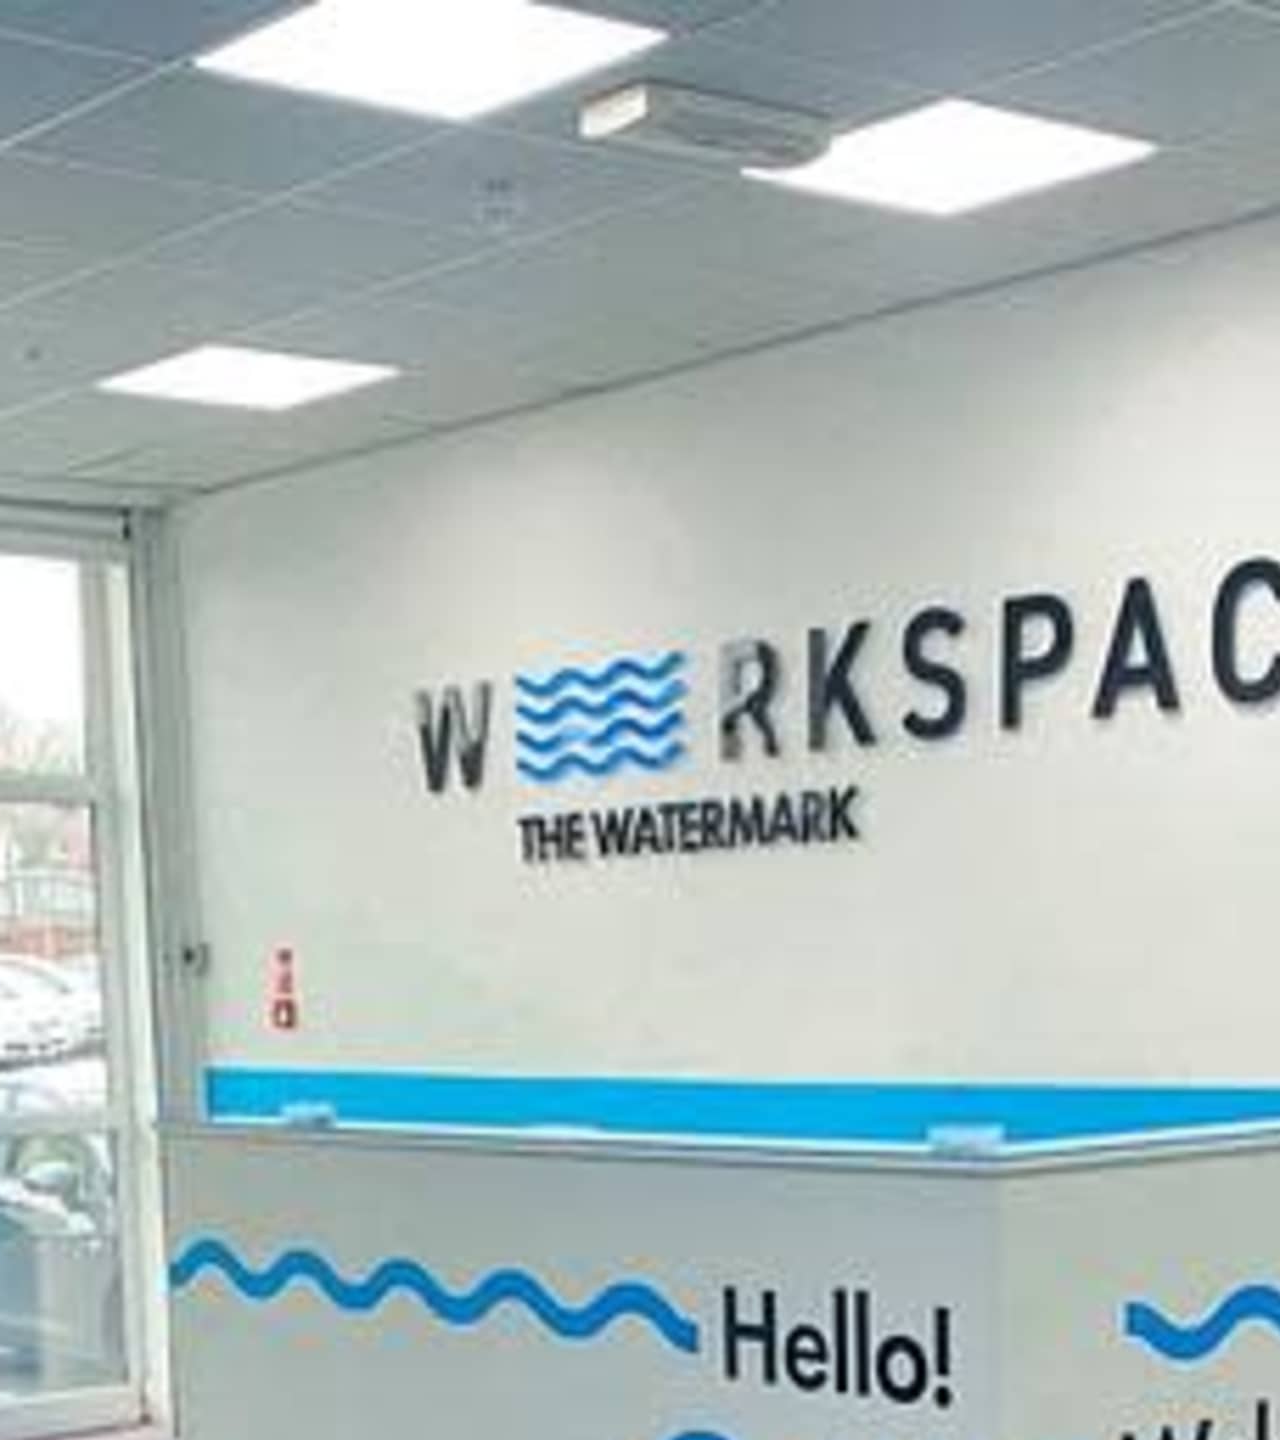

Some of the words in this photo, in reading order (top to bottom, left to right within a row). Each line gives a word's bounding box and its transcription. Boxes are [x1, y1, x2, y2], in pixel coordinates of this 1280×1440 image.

[519, 813, 584, 863] THE
[593, 786, 860, 859] WATERMARK
[721, 1285, 954, 1407] Hello!
